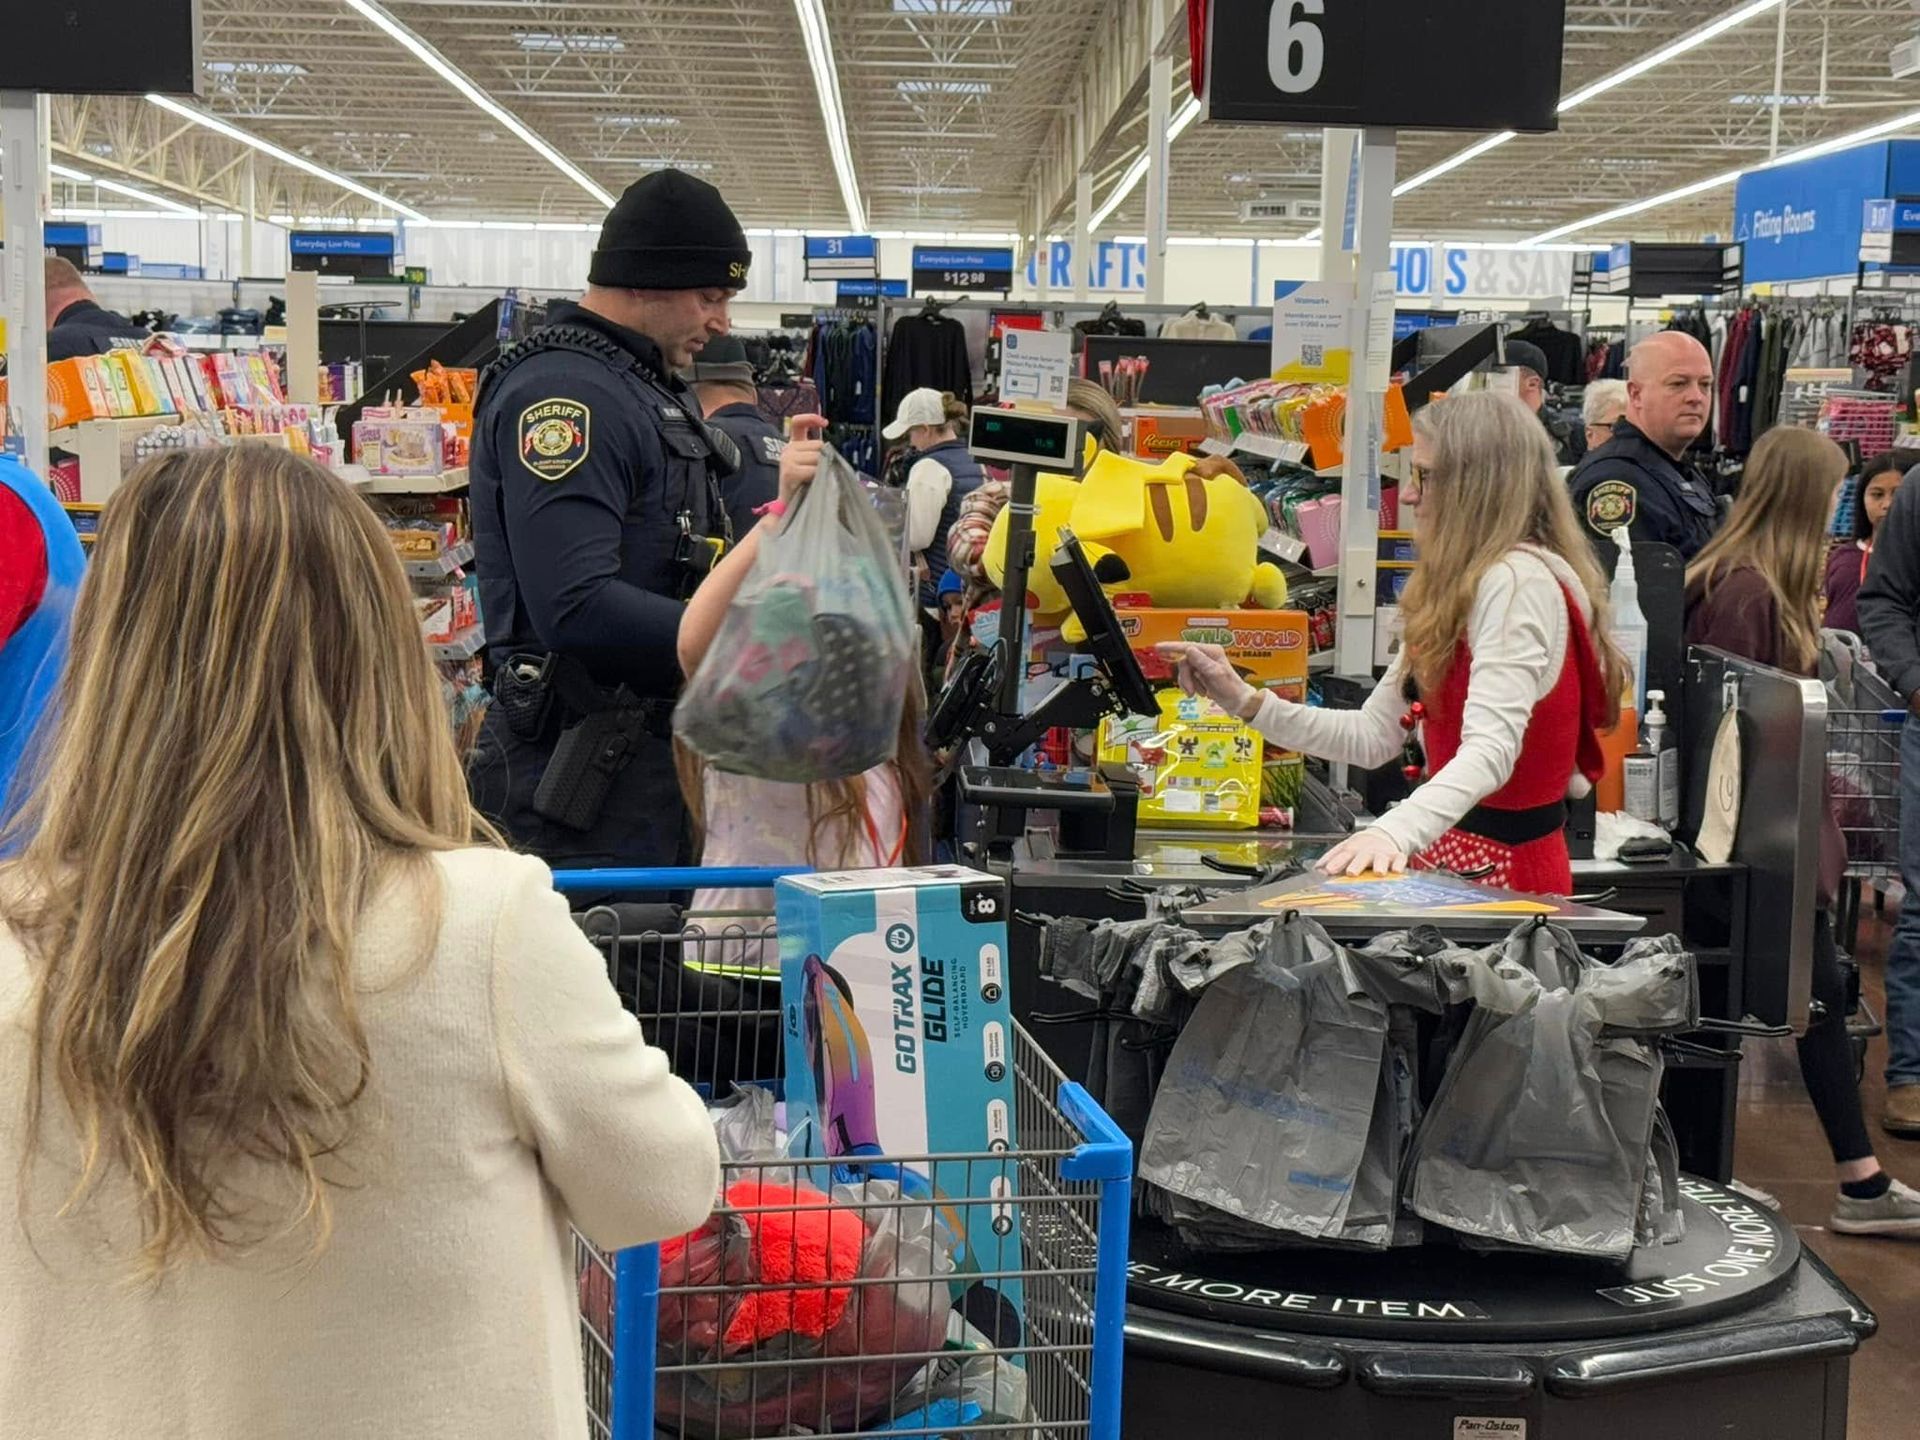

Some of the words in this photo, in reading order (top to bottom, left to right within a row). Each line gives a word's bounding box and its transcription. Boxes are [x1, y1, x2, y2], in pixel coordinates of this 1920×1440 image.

[1267, 0, 1325, 94] 6
[295, 239, 326, 248] Everyday
[1753, 210, 1782, 244] Fitting
[1783, 205, 1816, 234] Rooms
[827, 239, 843, 254] 31
[920, 255, 951, 264] Everyday
[1475, 250, 1499, 294] &
[526, 404, 583, 423] SHERIFF
[1181, 627, 1235, 648] WILD
[1233, 629, 1303, 649] WORLD
[921, 956, 948, 1043] GLIDE
[950, 957, 961, 1039] SELF-BALANCING
[960, 965, 969, 1030] HOVERBOARD
[889, 962, 917, 1075] GOTRAX
[1711, 1203, 1776, 1249] MORE
[1704, 1246, 1772, 1277] ONE
[1149, 1273, 1317, 1309] MORE
[1332, 1298, 1466, 1318] ITEM
[1621, 1273, 1721, 1302] JUST
[1459, 1418, 1520, 1431] Pan-Oston
